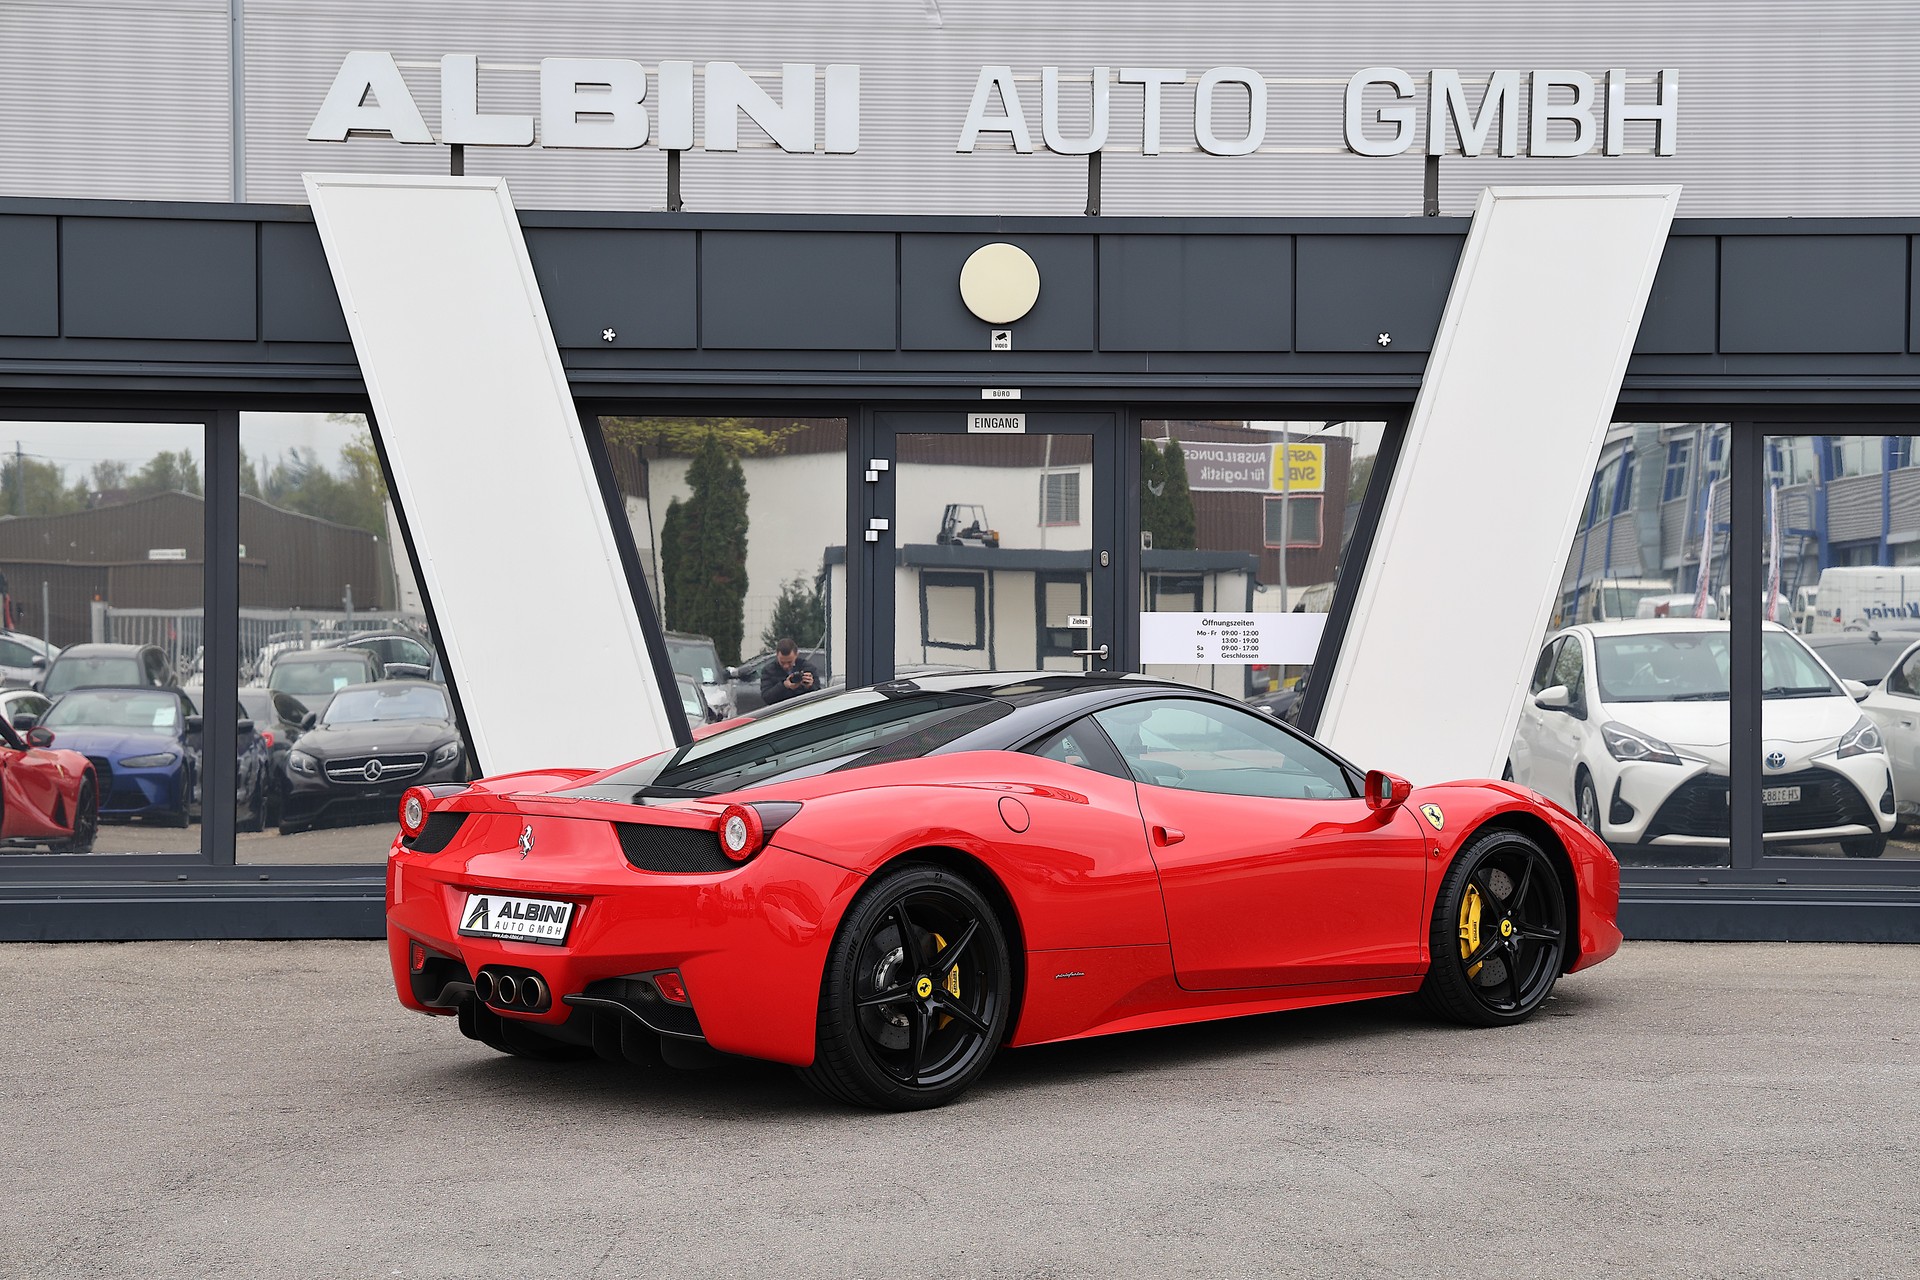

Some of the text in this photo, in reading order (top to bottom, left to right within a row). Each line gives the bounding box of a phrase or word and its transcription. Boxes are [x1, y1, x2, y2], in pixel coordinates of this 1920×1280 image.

[307, 51, 1679, 158] ALBINI AUTO GMBH
[992, 389, 1011, 397] BÜRO
[974, 417, 1019, 429] EINGANG
[1201, 618, 1255, 628] Öffnungszeiten
[498, 901, 568, 924] ALBINI
[494, 920, 562, 936] AUTO GMBH
